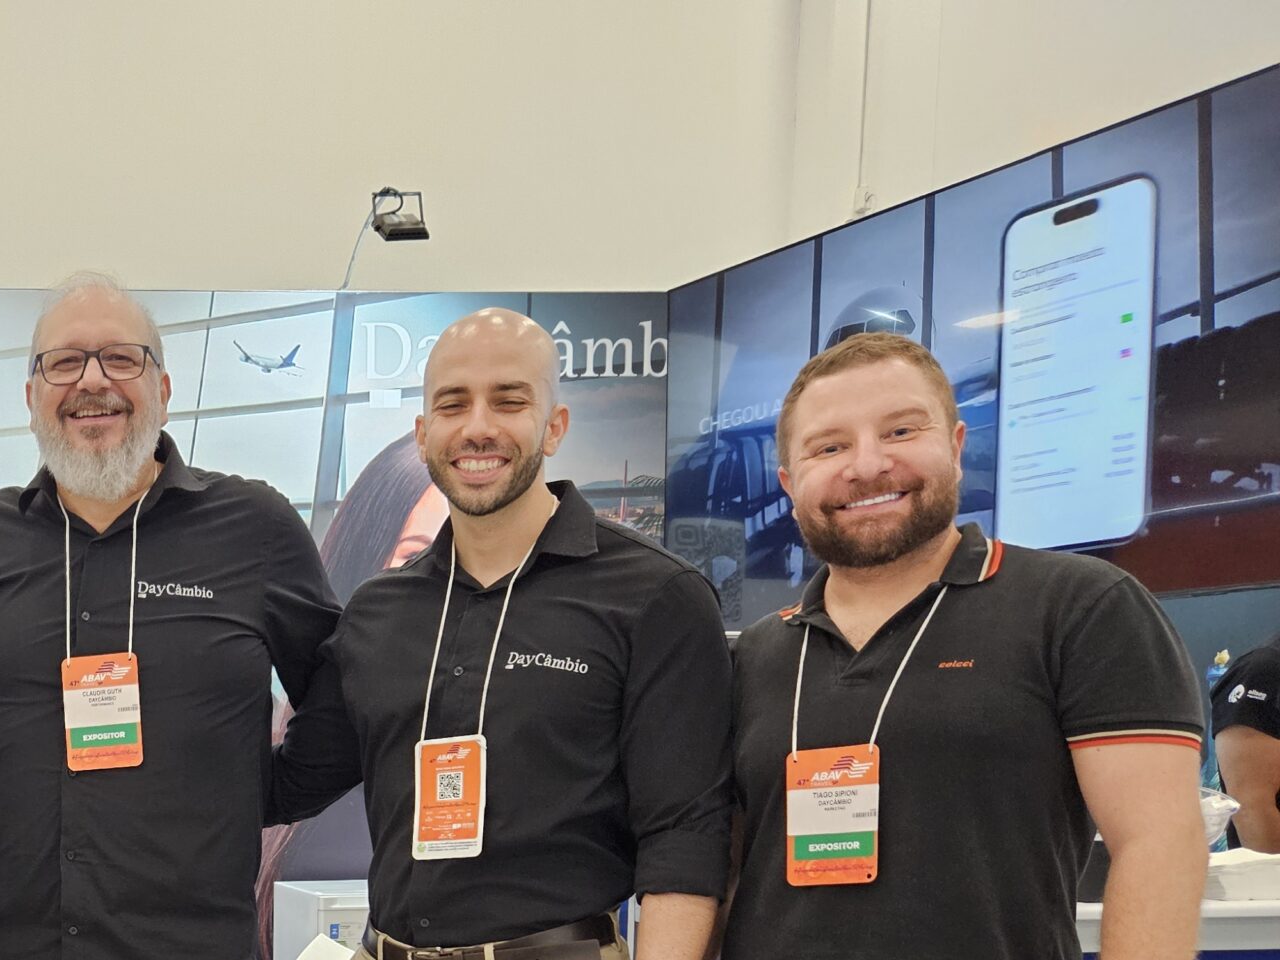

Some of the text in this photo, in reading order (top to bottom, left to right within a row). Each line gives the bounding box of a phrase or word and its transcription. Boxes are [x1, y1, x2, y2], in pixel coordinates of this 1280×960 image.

[699, 405, 766, 435] CHEGOU
[137, 581, 214, 599] DayCâmbio
[506, 652, 589, 674] DayCâmbio
[80, 673, 107, 683] ABAV
[83, 731, 126, 742] EXPOSITOR
[810, 770, 842, 781] ABAV
[808, 841, 860, 852] EXPOSITOR
